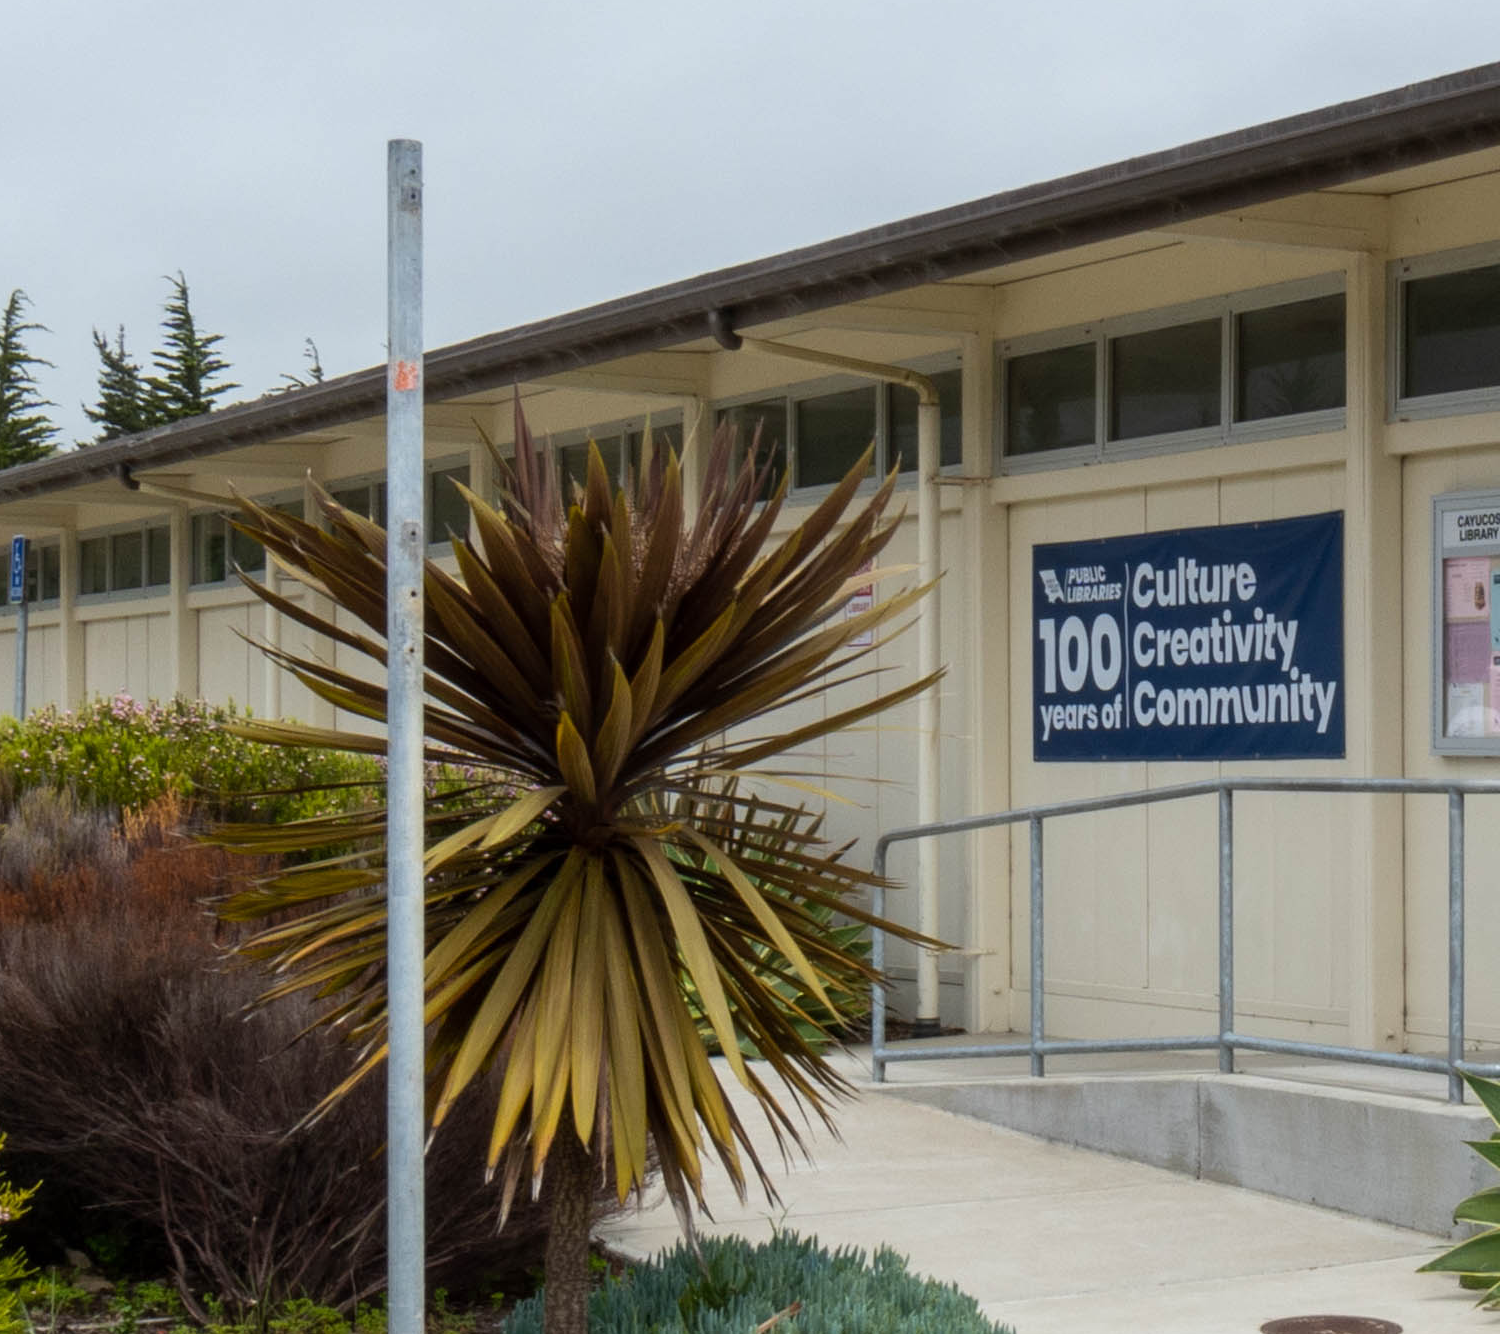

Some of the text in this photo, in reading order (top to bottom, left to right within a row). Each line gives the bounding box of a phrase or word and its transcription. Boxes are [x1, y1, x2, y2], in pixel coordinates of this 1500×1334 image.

[1457, 513, 1500, 527] CAYUCOS
[1459, 528, 1499, 541] LIBRARY
[1067, 565, 1107, 584] PUBLIC
[1067, 582, 1122, 603] LIBRARIES
[1132, 556, 1257, 608] Culture
[1039, 613, 1122, 693] 100
[1133, 607, 1298, 672] Creativity
[1040, 693, 1122, 742] years of
[1133, 666, 1337, 734] Community
